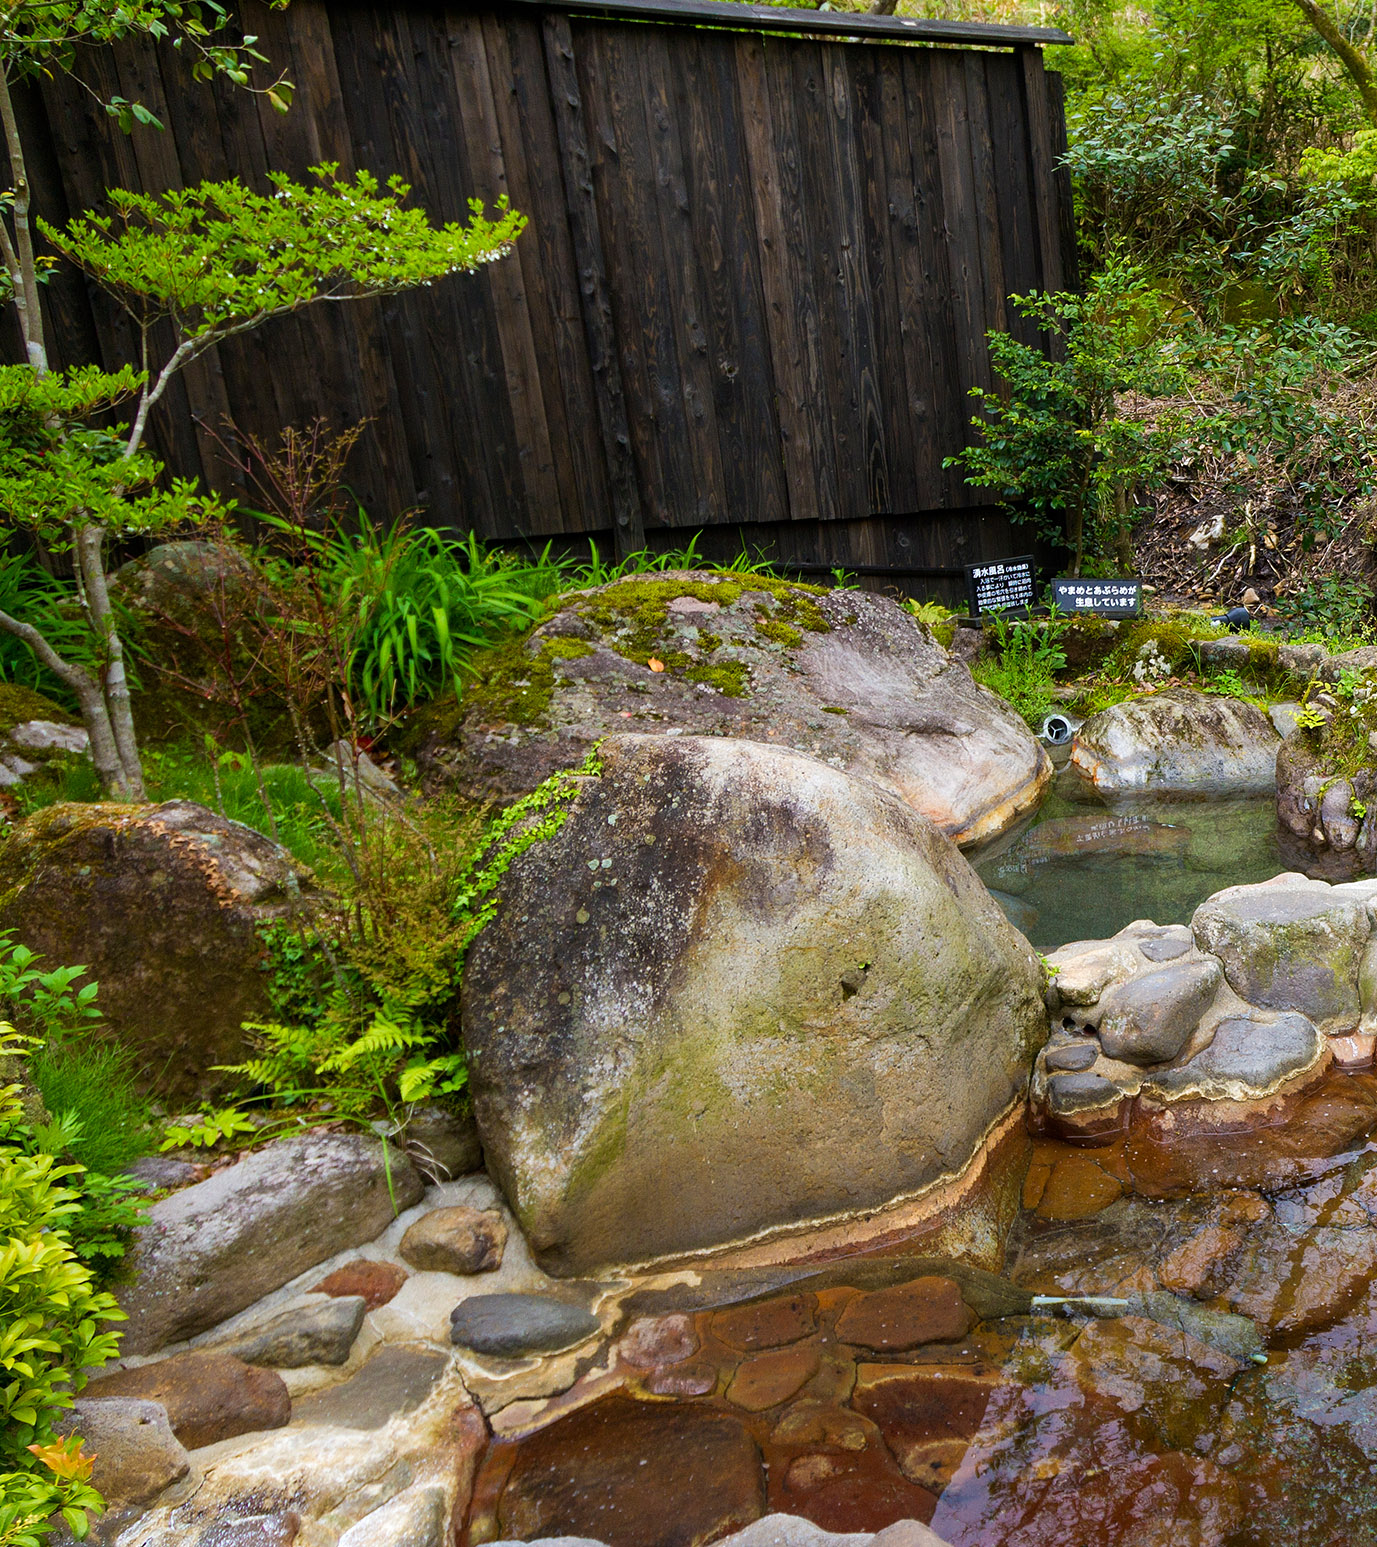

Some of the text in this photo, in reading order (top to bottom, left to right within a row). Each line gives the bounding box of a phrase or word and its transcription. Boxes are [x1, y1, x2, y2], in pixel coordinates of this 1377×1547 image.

[1058, 585, 1137, 596] やまめとあぶらめが
[1075, 597, 1136, 608] 生息しています
